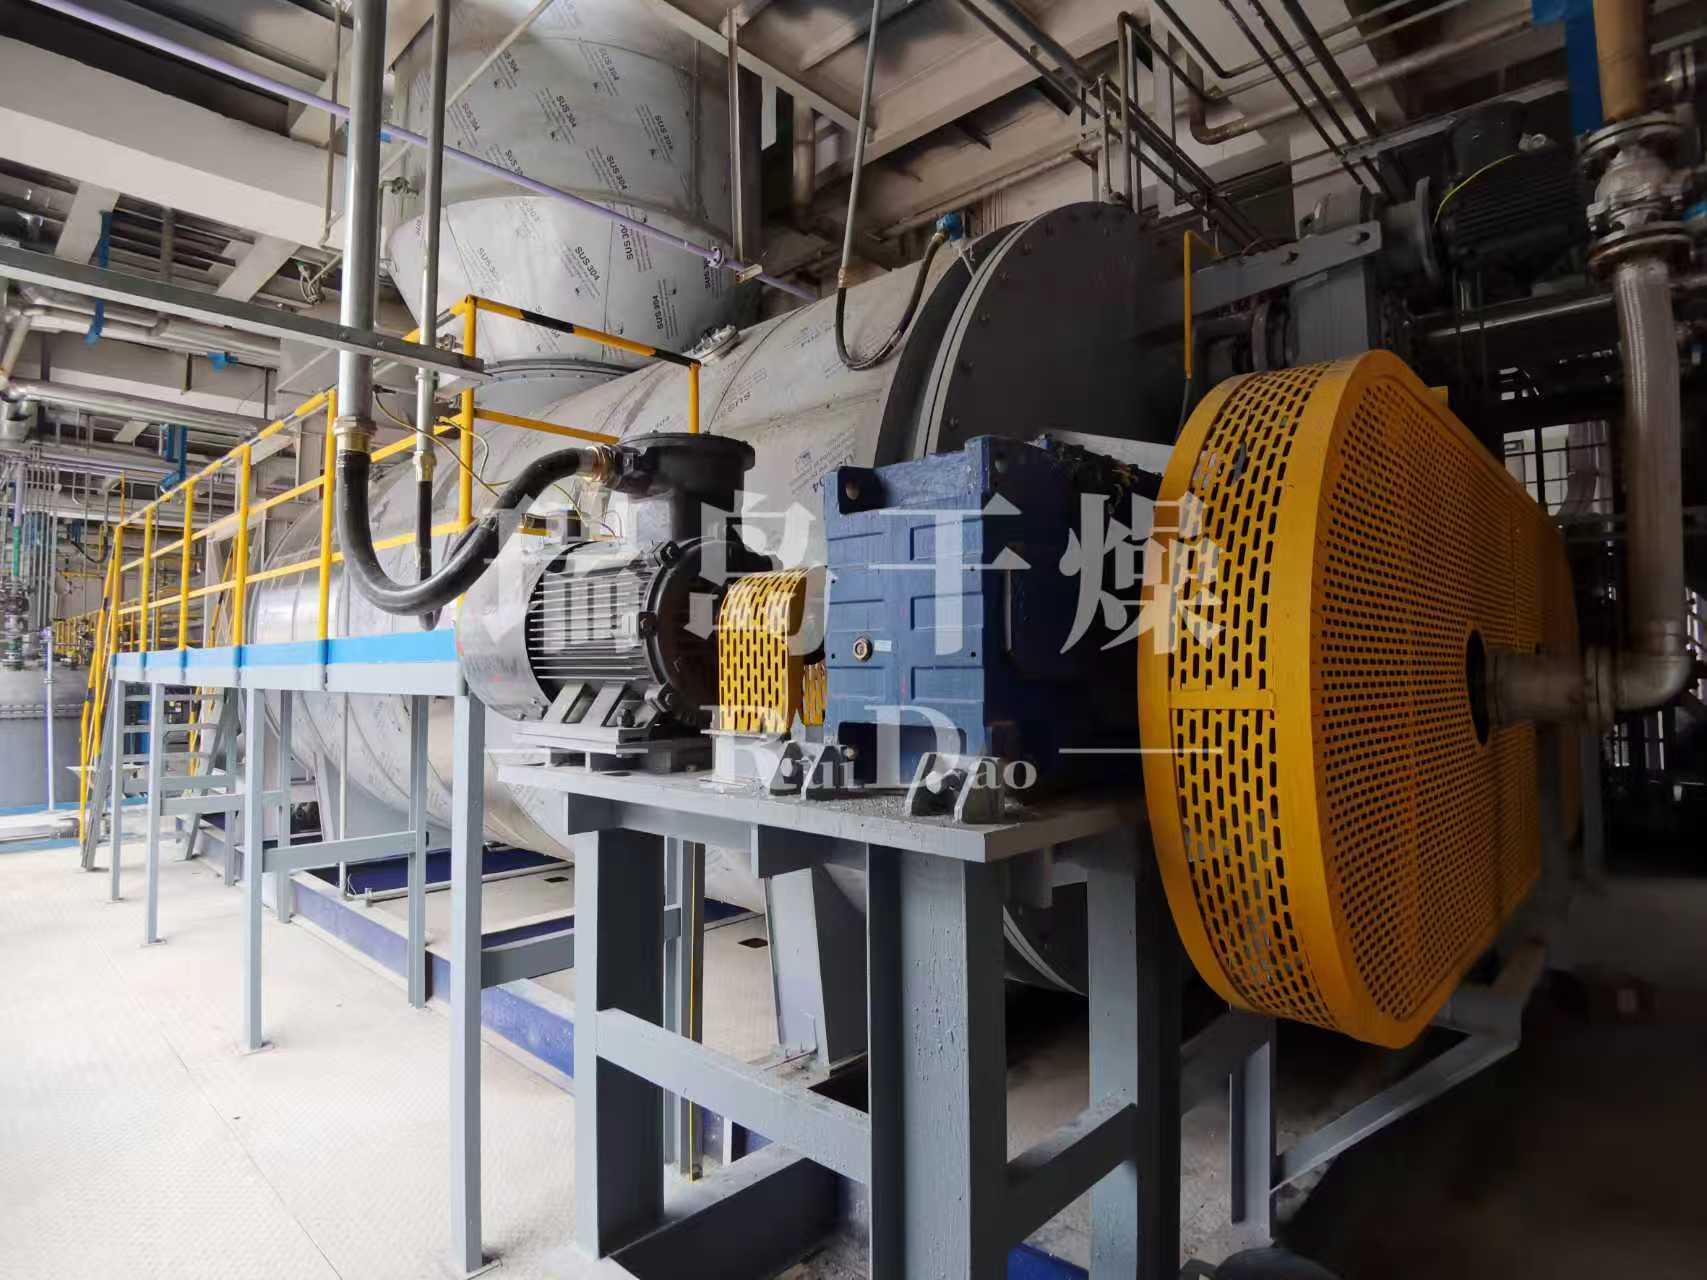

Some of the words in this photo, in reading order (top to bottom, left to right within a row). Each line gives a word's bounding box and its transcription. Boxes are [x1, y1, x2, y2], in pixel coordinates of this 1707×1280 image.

[556, 95, 569, 112] SUS
[566, 112, 577, 127] 304
[654, 114, 667, 133] SUS
[505, 150, 517, 166] SUS
[606, 154, 620, 174] SUS
[616, 174, 627, 189] 304
[622, 239, 634, 260] SUS
[574, 246, 590, 265] SUS
[587, 265, 600, 280] 304
[652, 294, 660, 309] 304
[654, 310, 664, 329] SUS
